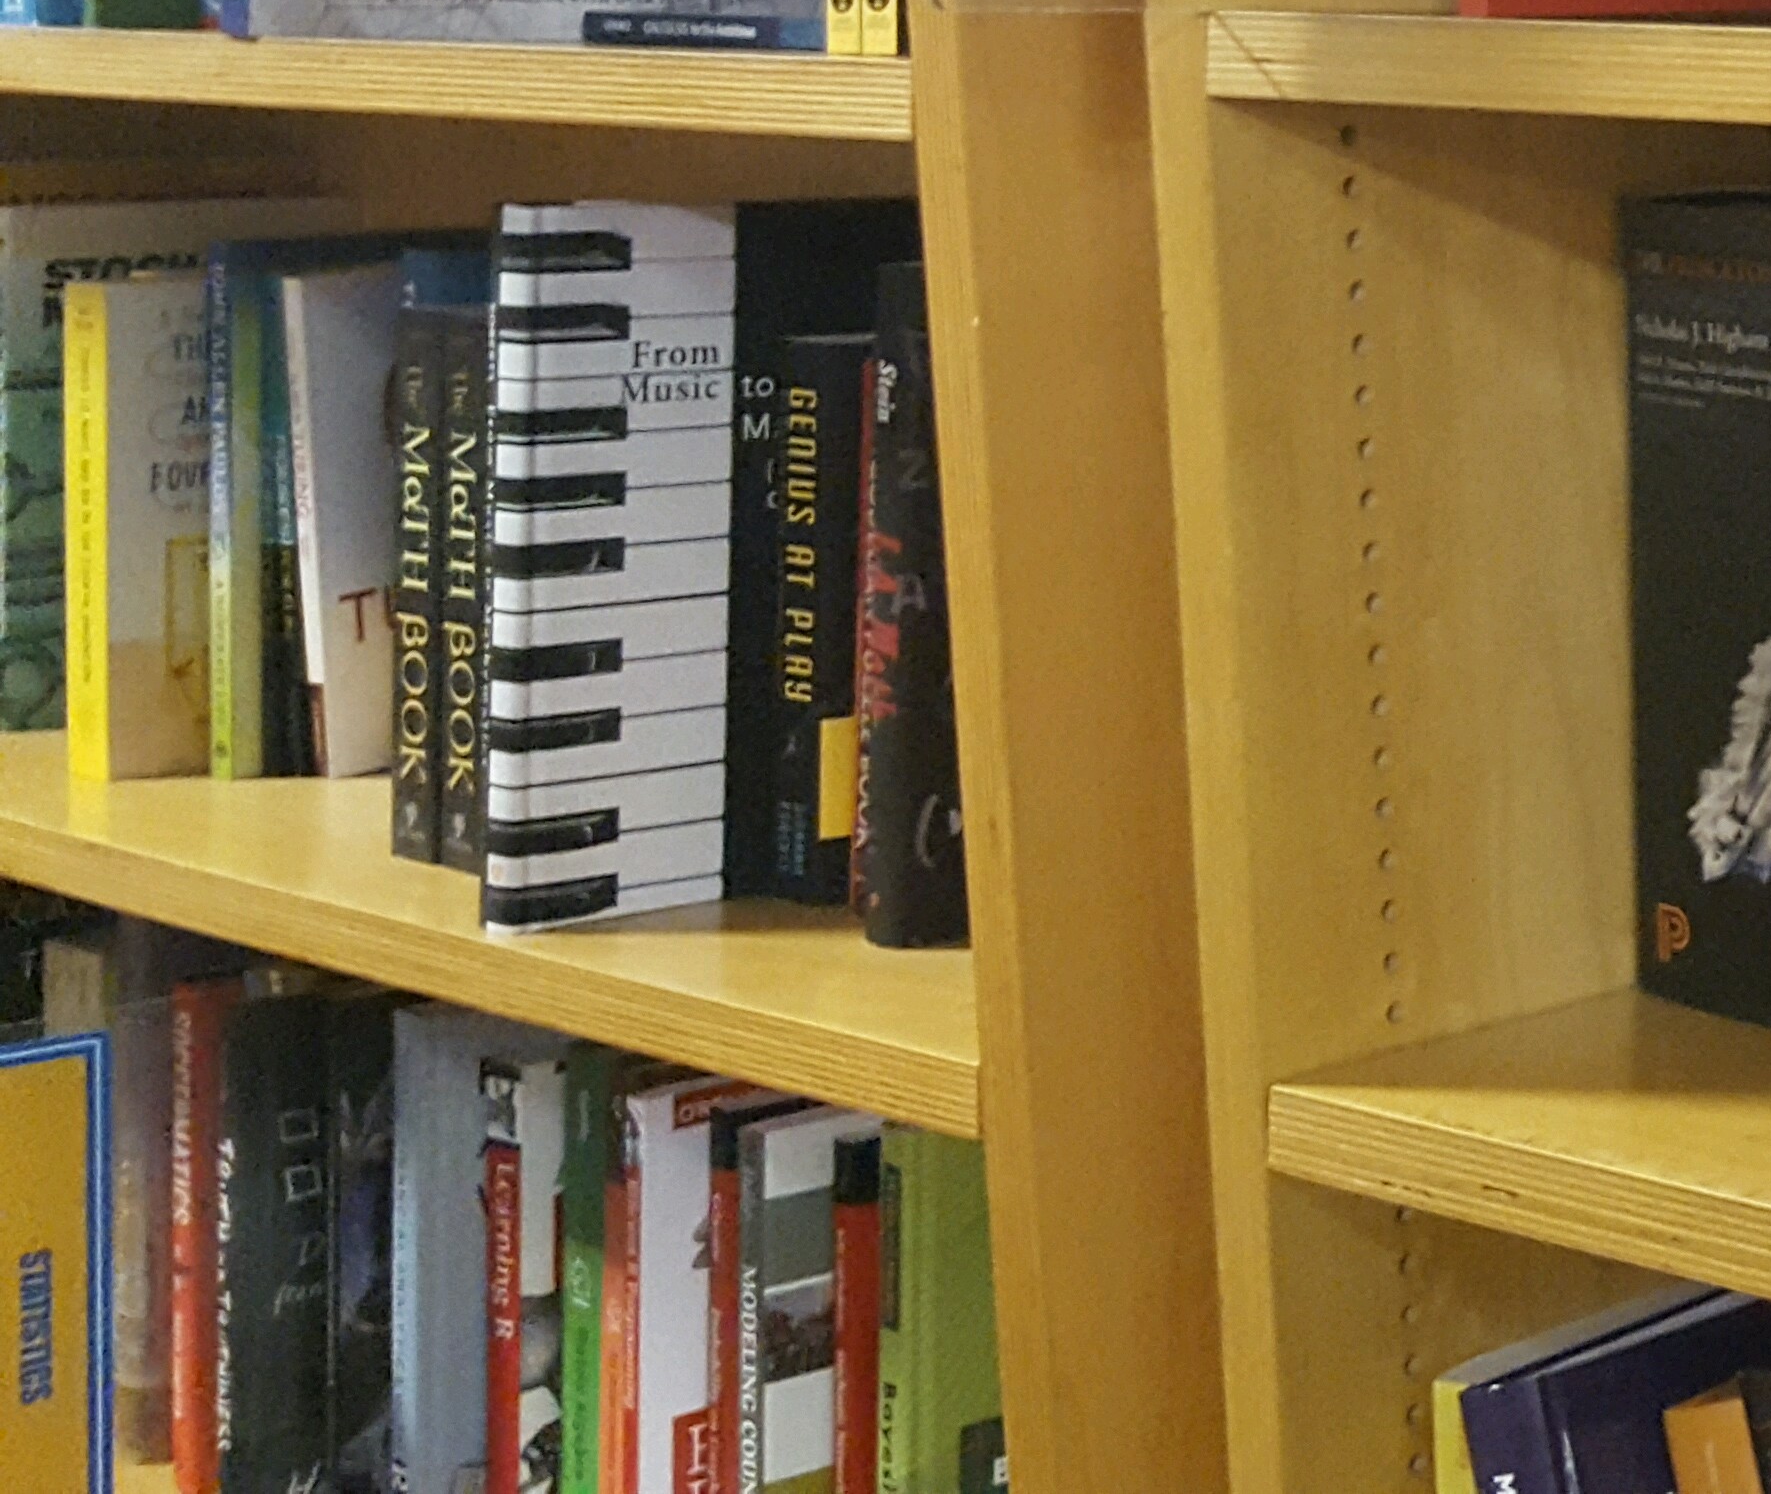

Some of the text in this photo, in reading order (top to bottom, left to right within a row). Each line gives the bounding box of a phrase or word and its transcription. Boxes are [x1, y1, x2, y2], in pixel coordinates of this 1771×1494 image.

[620, 374, 721, 404] Music
[632, 340, 721, 369] From
[742, 376, 774, 398] to
[876, 360, 899, 423] Stein
[785, 386, 817, 703] GENIUS AT PLAY
[397, 610, 429, 785] BOOK
[444, 620, 477, 793] BOOK
[19, 1248, 53, 1405] STATISTICS
[489, 1162, 518, 1339] Learning R
[739, 1265, 758, 1412] MODELING
